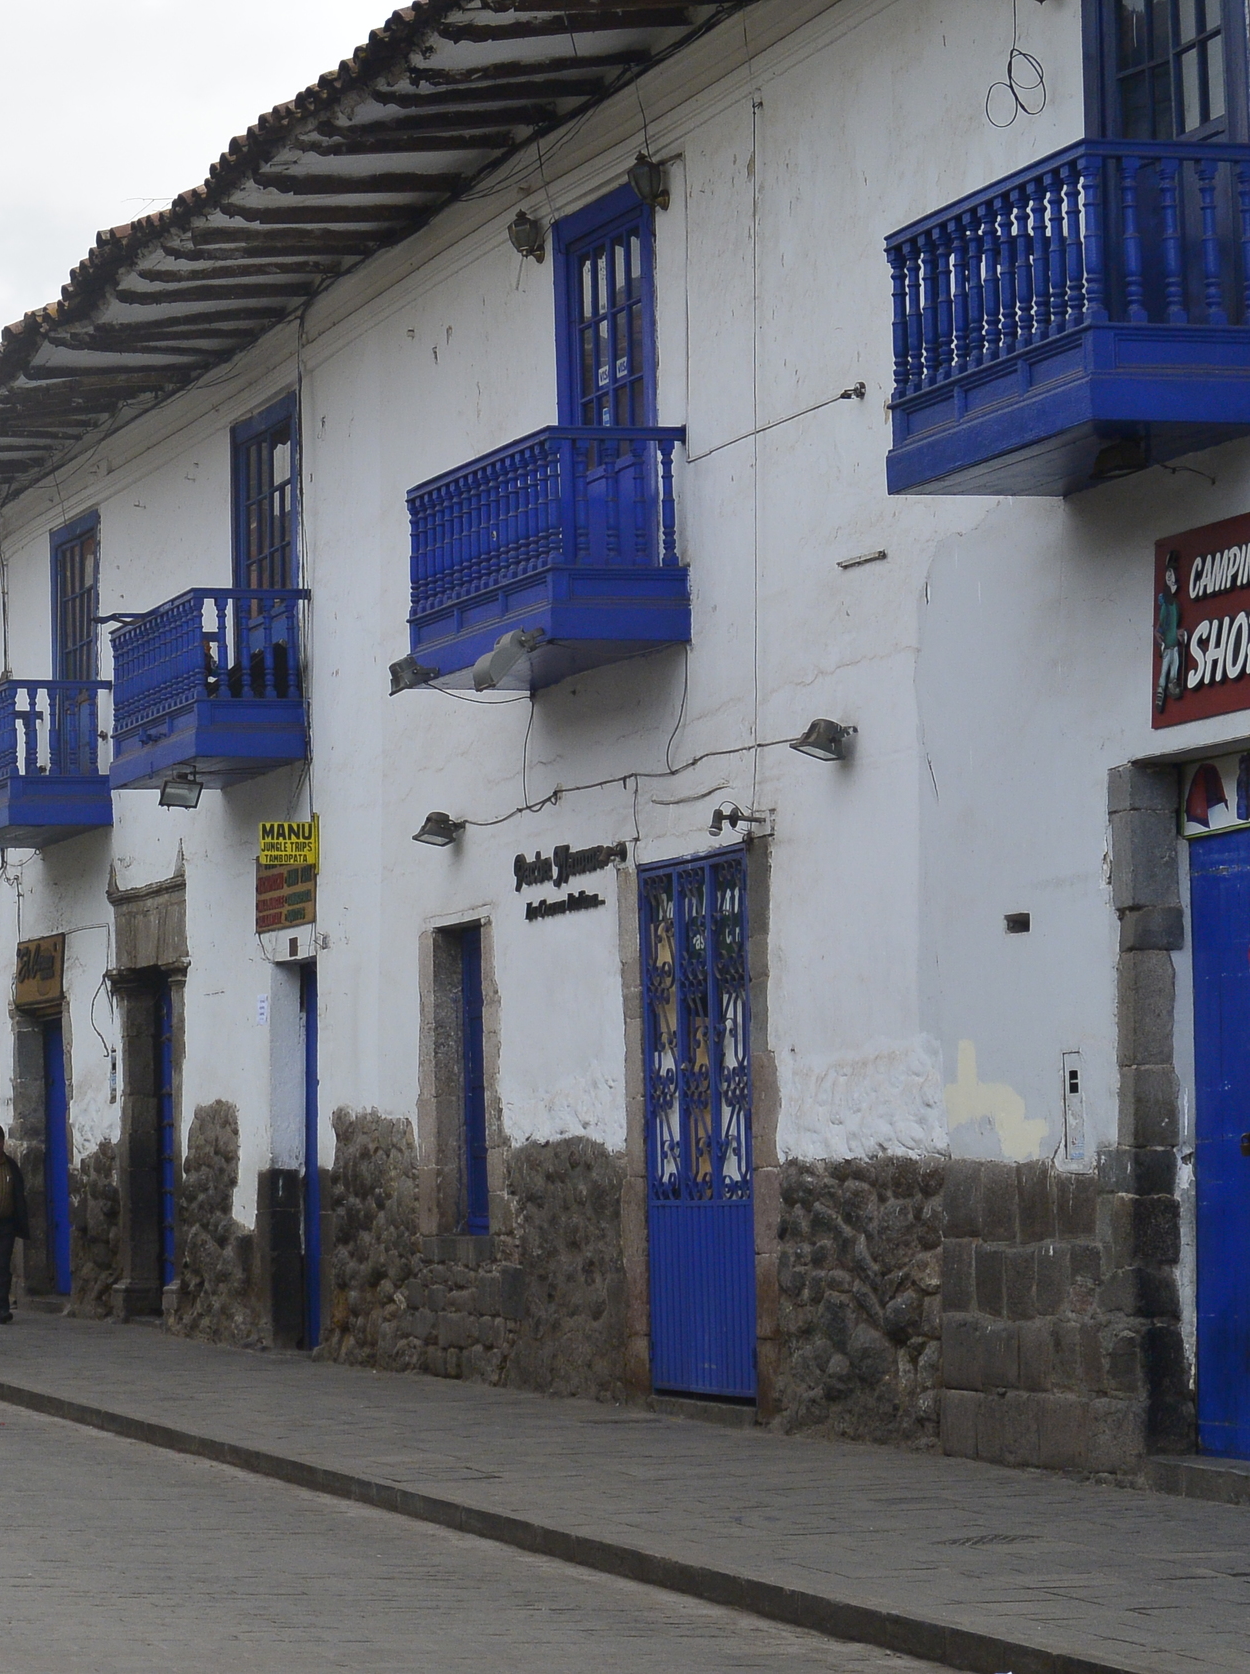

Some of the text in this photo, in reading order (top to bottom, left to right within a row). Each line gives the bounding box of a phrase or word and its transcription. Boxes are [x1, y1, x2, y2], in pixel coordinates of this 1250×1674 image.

[1187, 611, 1250, 689] SHO
[262, 823, 312, 840] MANU
[261, 841, 312, 853] JUNGLE TRIPS
[265, 854, 308, 863] TAMBOPATA
